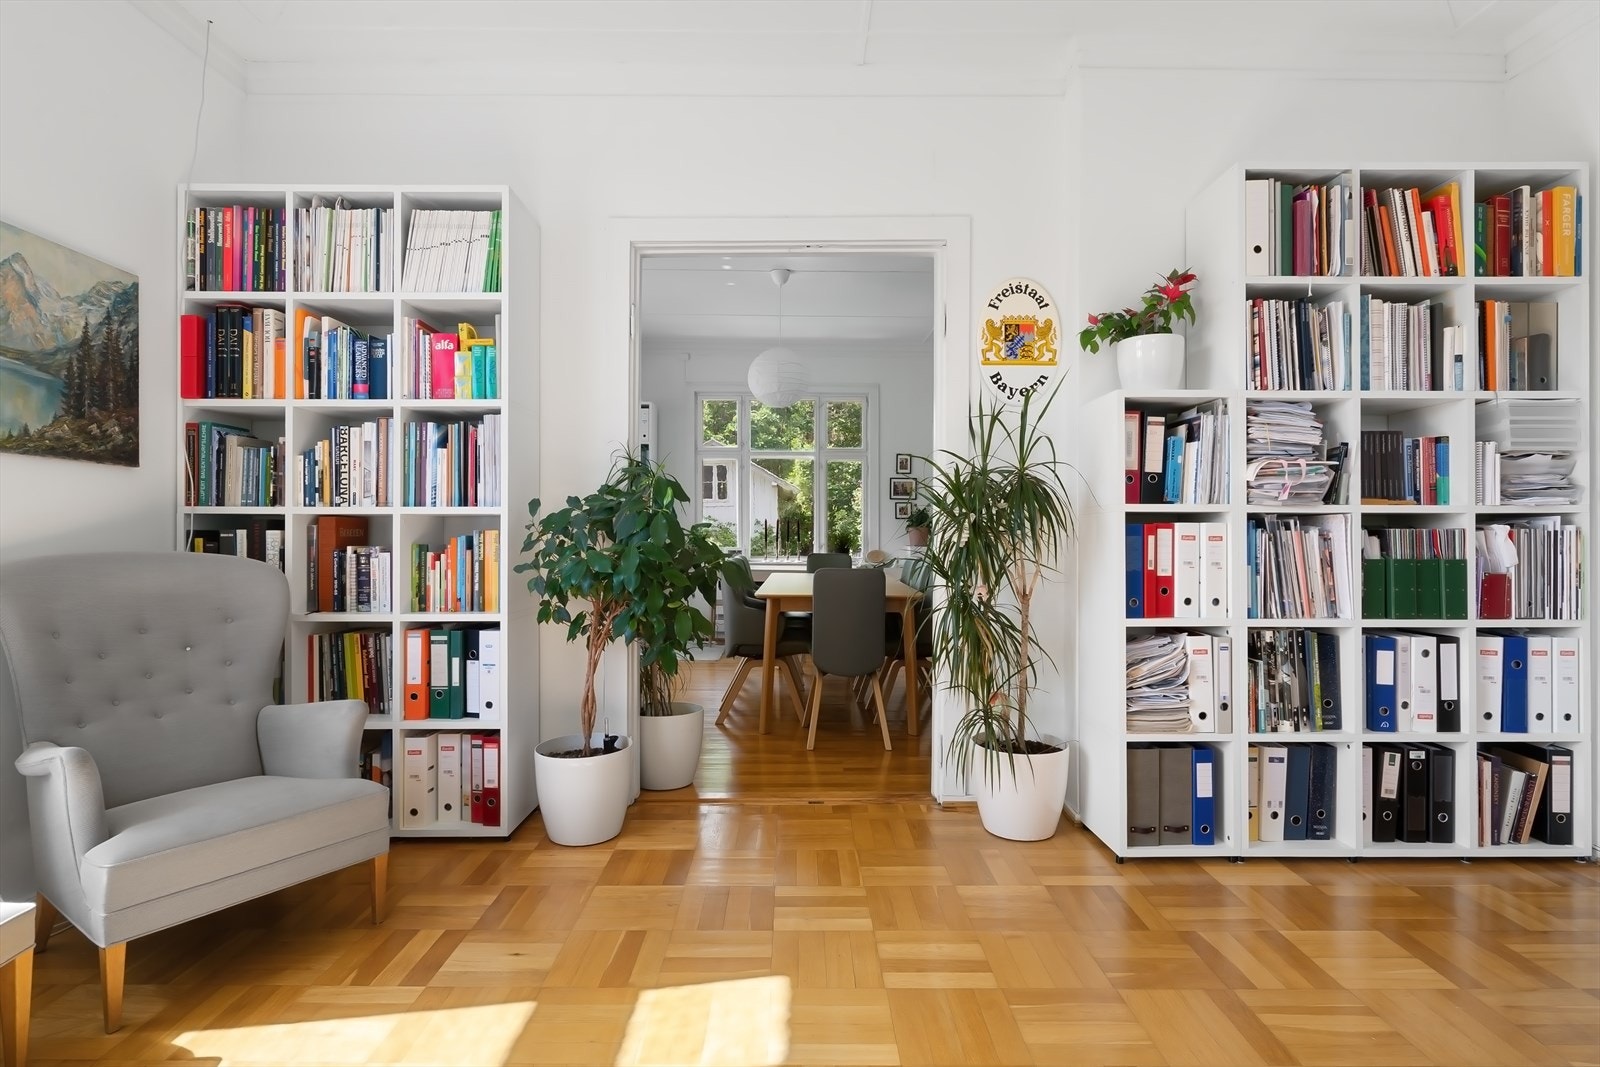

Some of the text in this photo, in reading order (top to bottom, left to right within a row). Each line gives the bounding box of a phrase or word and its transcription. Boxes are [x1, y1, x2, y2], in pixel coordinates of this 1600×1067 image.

[1562, 193, 1572, 237] FARGER
[988, 282, 1050, 310] Freistaat
[434, 339, 454, 350] alfa
[989, 371, 1049, 400] Bayern
[340, 428, 349, 504] BARCELONA
